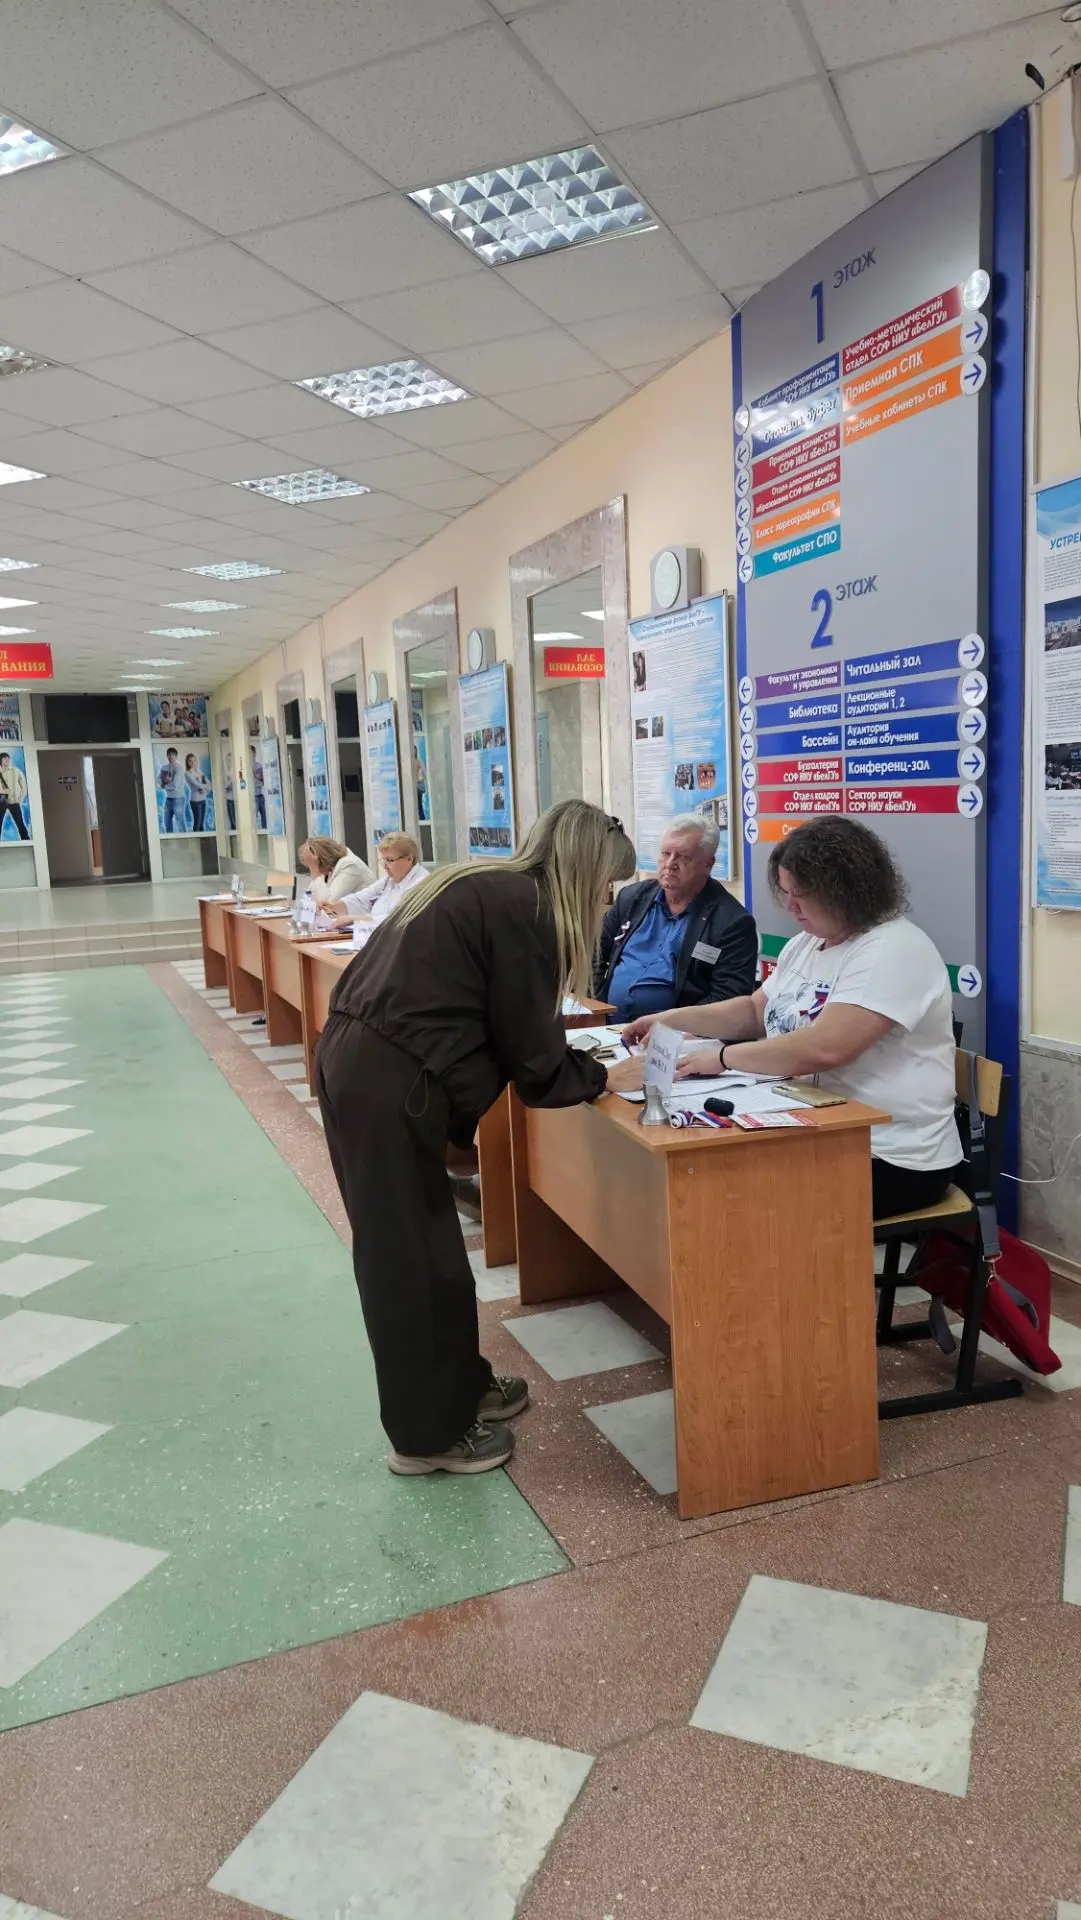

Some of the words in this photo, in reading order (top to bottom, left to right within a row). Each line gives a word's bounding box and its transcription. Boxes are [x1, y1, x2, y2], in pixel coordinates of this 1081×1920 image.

[811, 280, 824, 344] 1
[833, 246, 876, 289] этаж
[845, 296, 943, 360] Учебно-методический
[845, 354, 869, 372] отдел
[870, 339, 890, 358] СОФ
[891, 328, 910, 348] НИУ
[911, 310, 948, 337] «БелГУ»
[845, 367, 898, 401] Приемная
[900, 350, 924, 374] СПК
[846, 414, 881, 437] Учебные
[882, 393, 925, 420] кабинеты
[927, 380, 948, 399] СПК
[769, 445, 801, 467] Приемная
[802, 428, 836, 450] комиссия
[779, 458, 795, 473] СОФ
[788, 487, 802, 499] СОФ
[755, 526, 775, 539] Класс
[775, 507, 821, 532] хореографии
[821, 499, 837, 513] СПК
[772, 540, 815, 564] Факультет
[816, 530, 838, 548] СПО
[1050, 531, 1081, 551] УСТРЕ
[811, 588, 833, 649] 2
[836, 575, 878, 601] этаж
[846, 654, 900, 677] Читальный
[902, 655, 922, 668] зал
[767, 672, 800, 686] Факультет
[800, 665, 838, 679] экономики
[793, 682, 798, 690] и
[798, 675, 838, 692] управления
[847, 688, 896, 703] Лекционные
[788, 703, 838, 719] Библиотека
[847, 701, 890, 716] аудитории
[899, 697, 906, 708] 2
[847, 723, 890, 737] Аудитория
[802, 732, 839, 748] Бассейн
[847, 733, 878, 747] он-лайн
[879, 732, 919, 746] обучения
[798, 760, 839, 772] Бухгалтерия
[848, 760, 930, 777] Конференц-зал
[783, 772, 799, 782] СОФ
[792, 791, 814, 801] Отдел
[814, 791, 840, 802] кадров
[848, 789, 877, 802] Сектор
[878, 791, 902, 802] науки
[783, 801, 800, 811] СОФ
[848, 801, 867, 812] СОФ
[867, 801, 884, 811] НИУ
[885, 800, 917, 811] «БелГУ»
